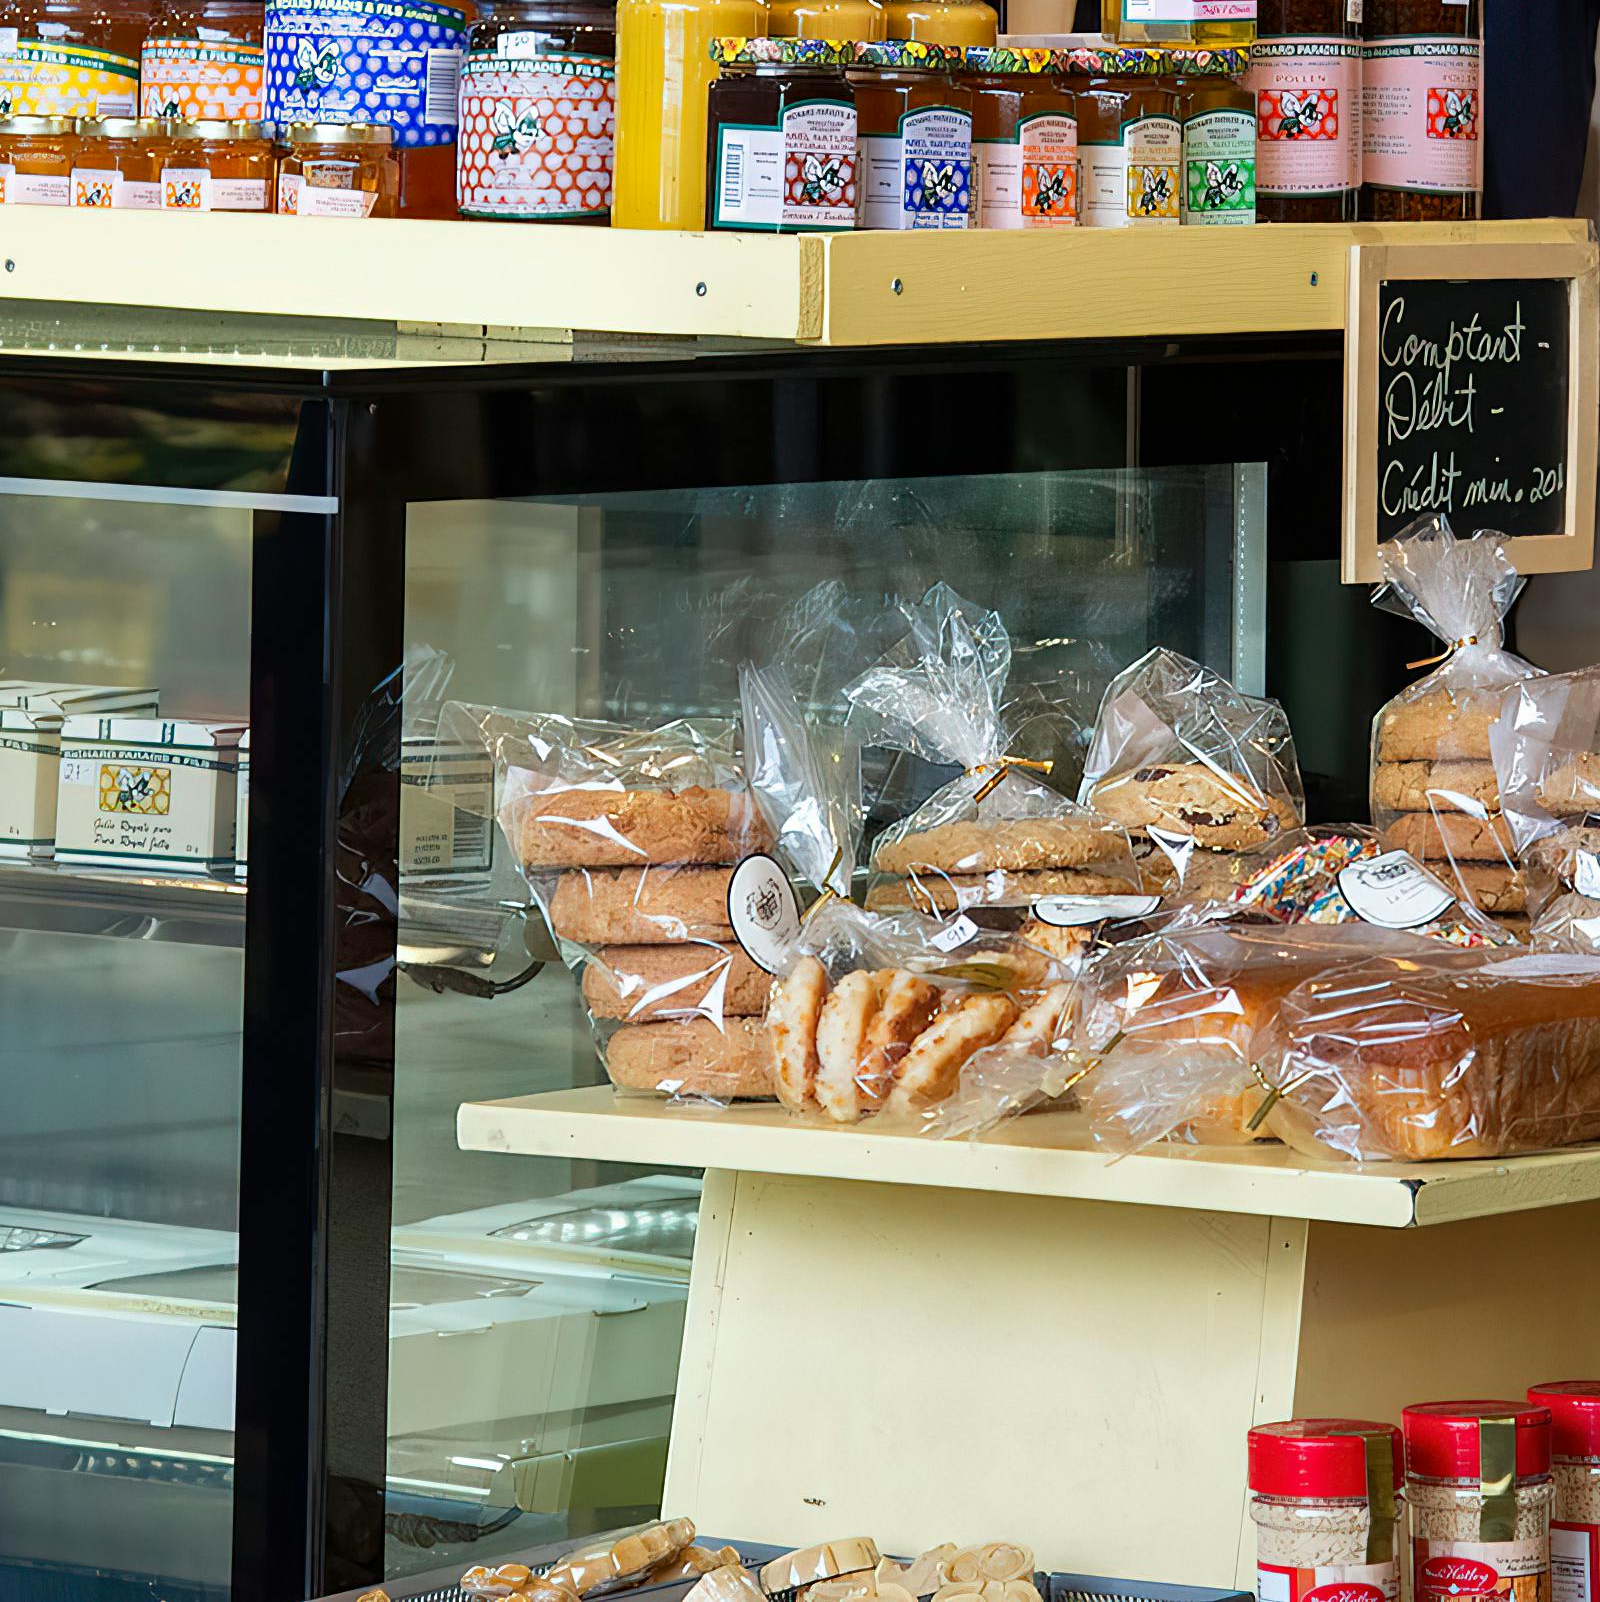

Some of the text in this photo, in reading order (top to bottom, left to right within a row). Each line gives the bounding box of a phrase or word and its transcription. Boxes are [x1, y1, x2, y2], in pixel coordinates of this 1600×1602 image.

[1381, 297, 1526, 395] Comptant
[1385, 371, 1477, 445] Débit
[1381, 451, 1462, 517] Crédit
